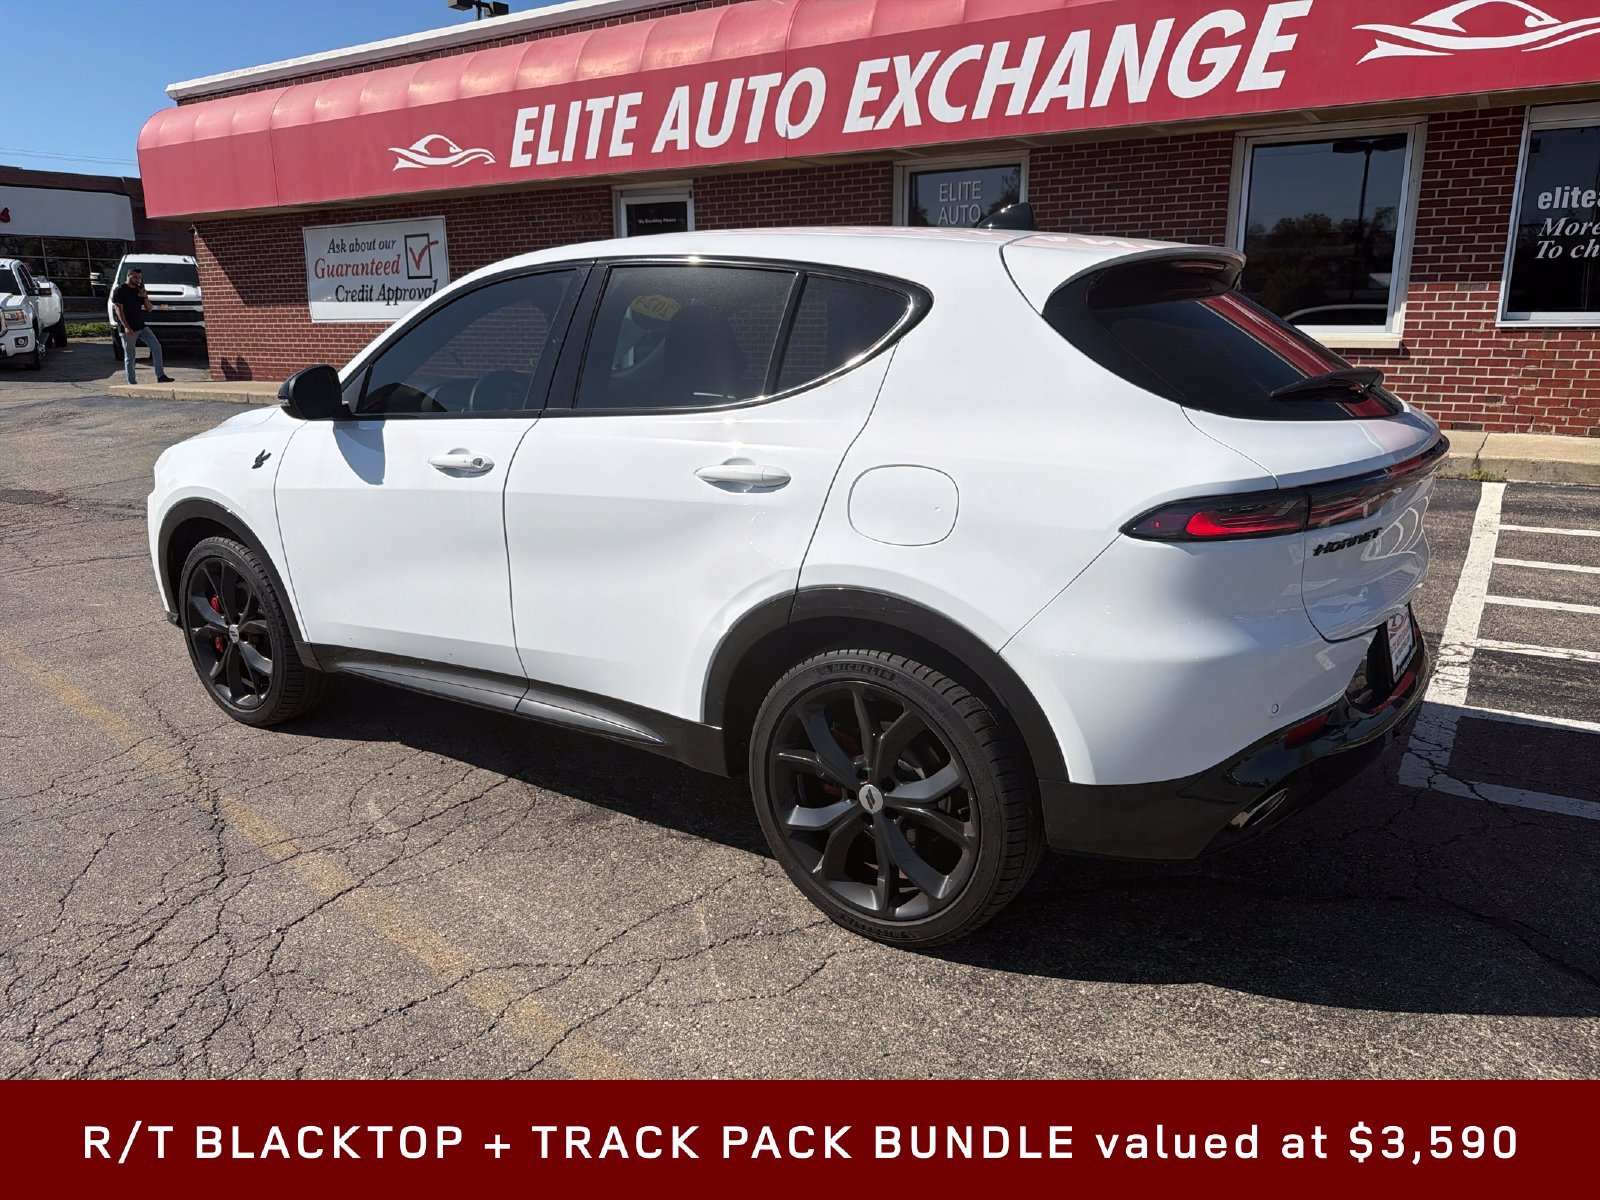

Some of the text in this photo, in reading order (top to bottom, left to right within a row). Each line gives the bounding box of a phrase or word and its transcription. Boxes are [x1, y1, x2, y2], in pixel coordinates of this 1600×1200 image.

[509, 0, 1313, 168] ELITE AUTO EXCHANGE
[939, 180, 983, 202] ELITE
[938, 203, 981, 225] AUTO
[1537, 216, 1600, 236] More
[327, 238, 397, 254] Ask about our
[1534, 240, 1563, 259] To
[314, 254, 401, 279] Guaranteed
[335, 278, 438, 306] Credit Approval
[831, 663, 895, 681] MICHELIN
